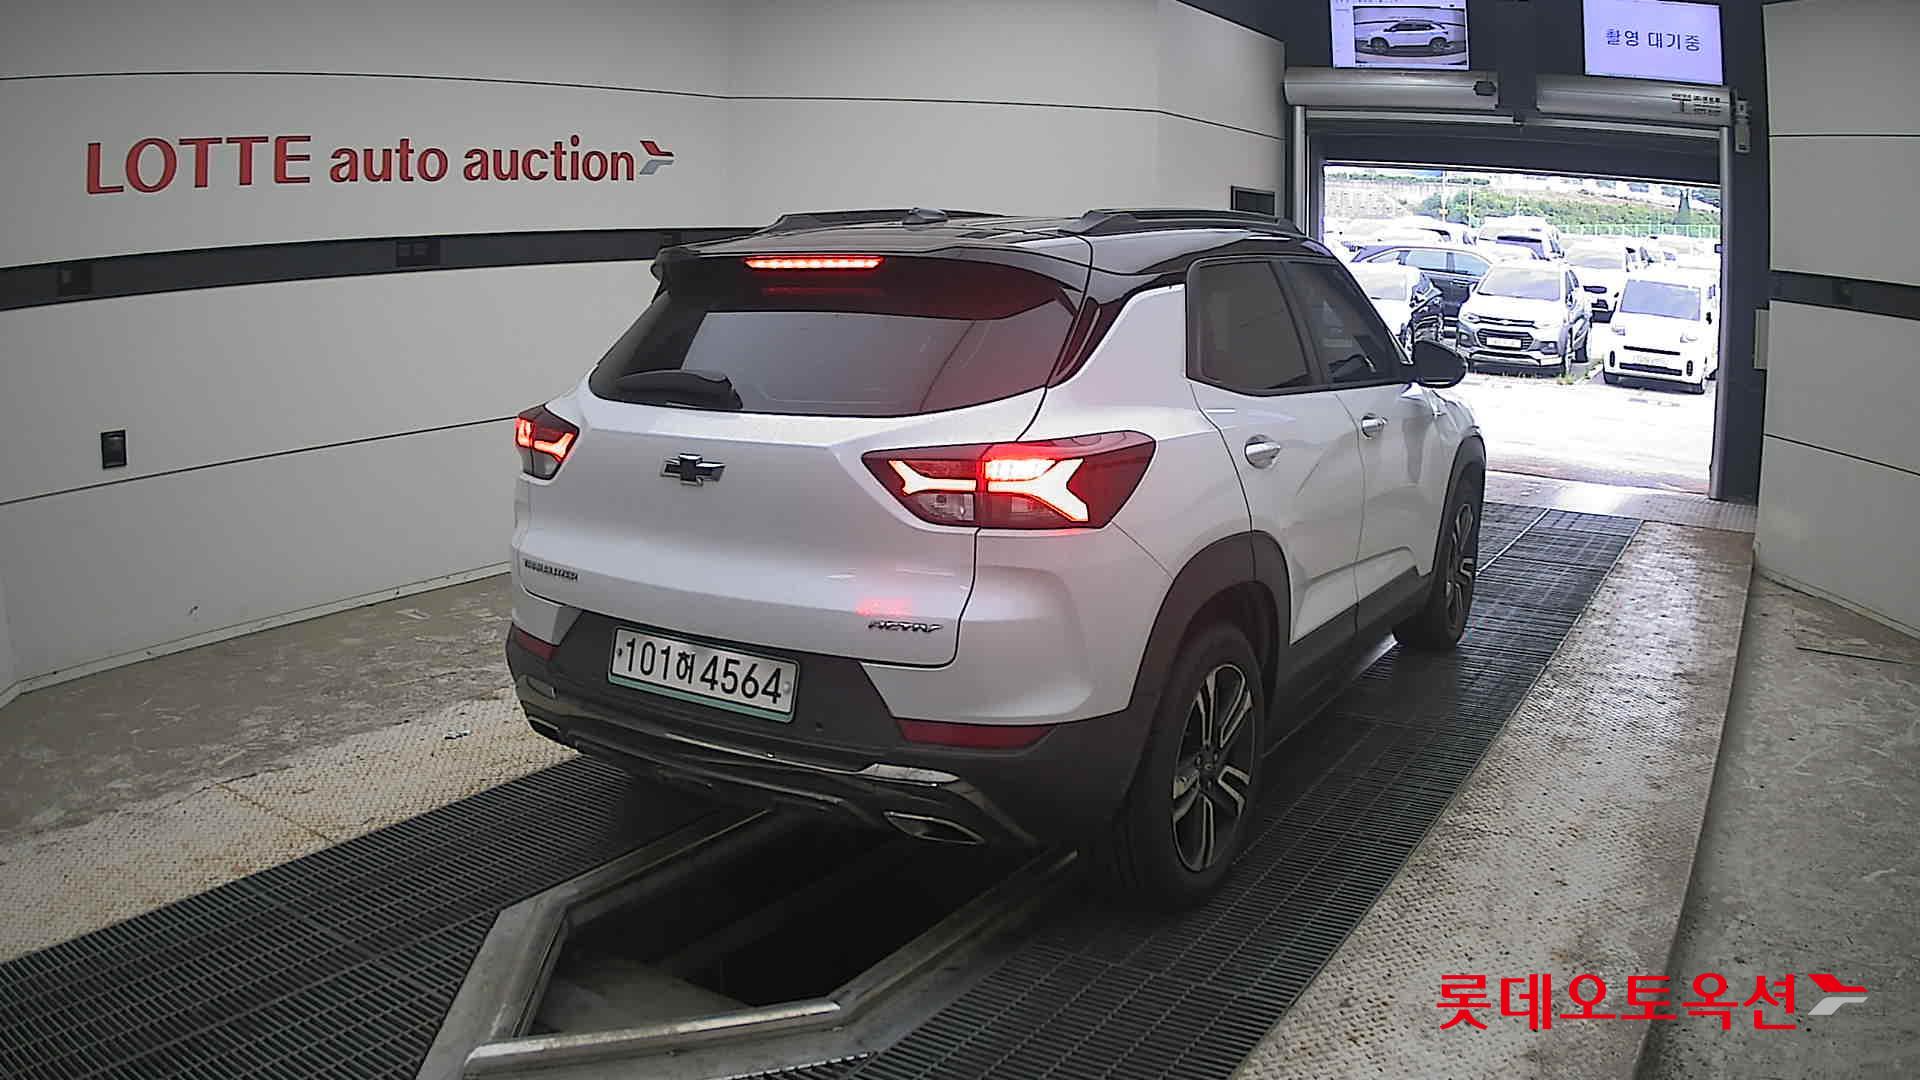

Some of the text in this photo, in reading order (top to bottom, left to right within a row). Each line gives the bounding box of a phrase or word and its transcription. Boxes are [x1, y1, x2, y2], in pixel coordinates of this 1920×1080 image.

[1647, 32, 1700, 51] 대기중
[86, 134, 634, 194] LOTTE auto auction
